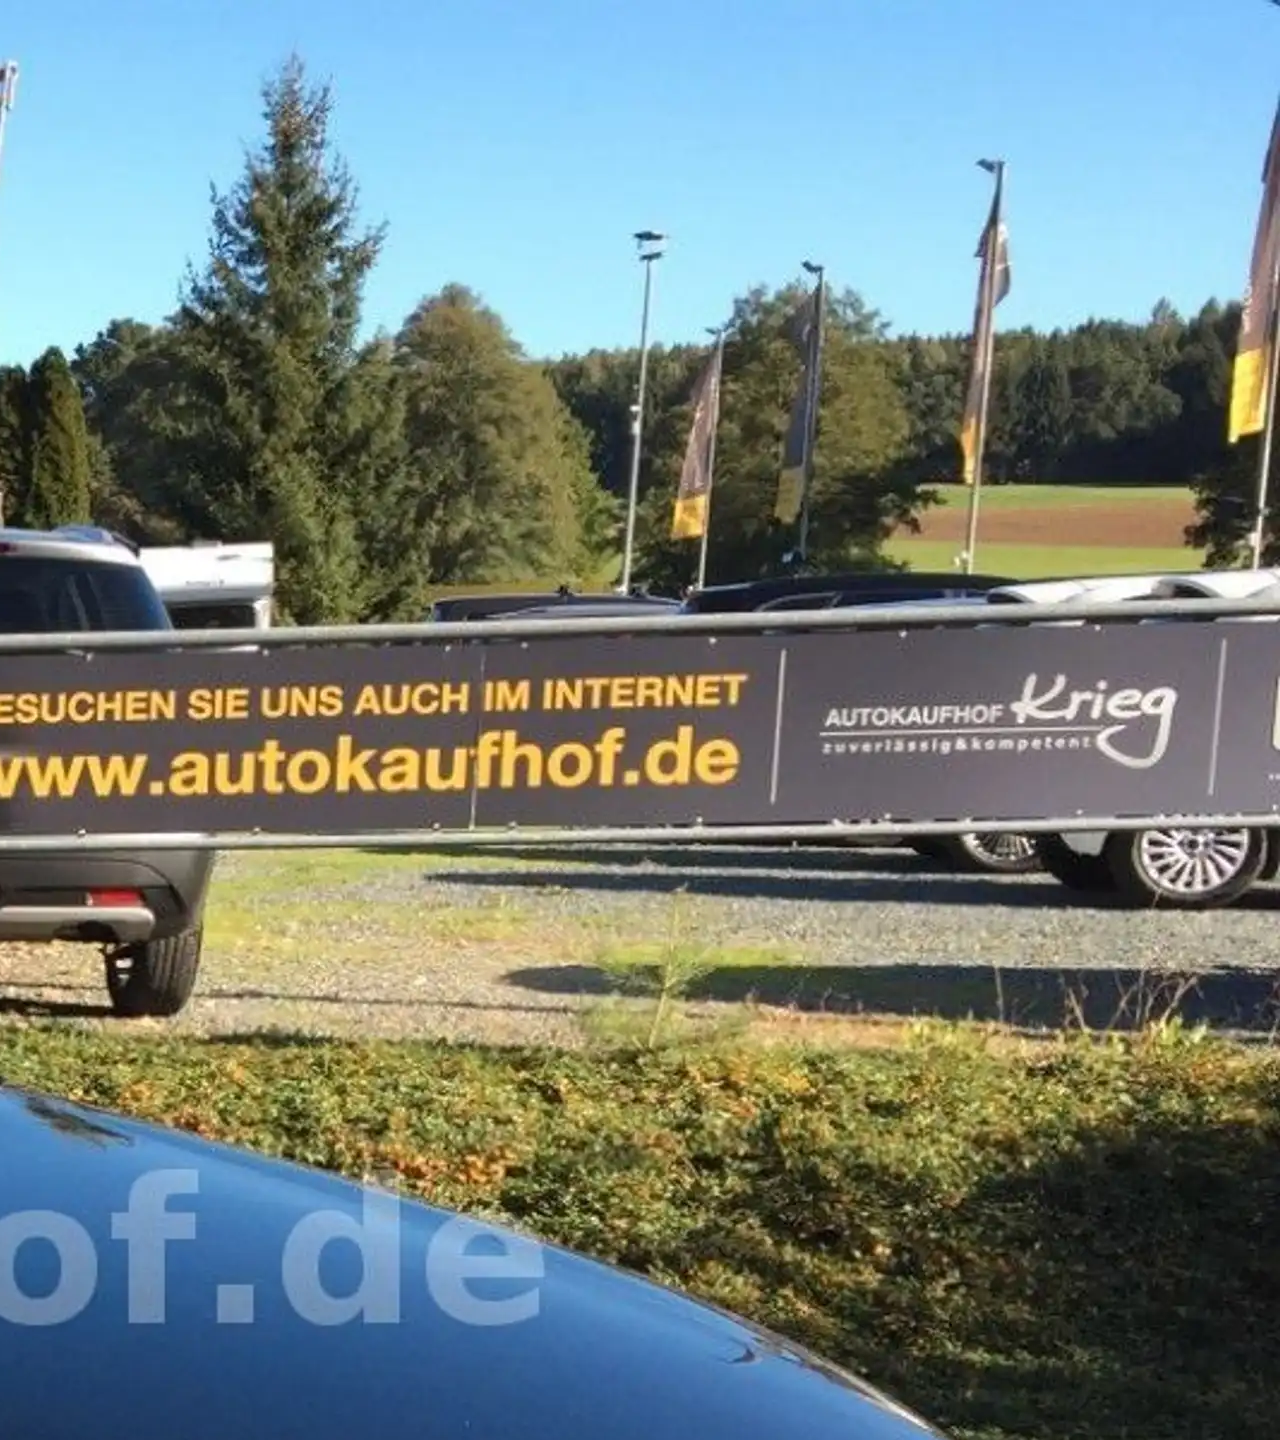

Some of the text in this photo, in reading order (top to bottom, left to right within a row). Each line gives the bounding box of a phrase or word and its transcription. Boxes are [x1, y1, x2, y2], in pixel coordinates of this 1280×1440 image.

[187, 688, 249, 720] SIE
[261, 685, 344, 718] UNS
[353, 681, 469, 716] AUCH
[484, 679, 530, 712] IM
[542, 673, 749, 711] INTERNET
[824, 672, 1178, 769] AUTOKAUFHOF Krieg
